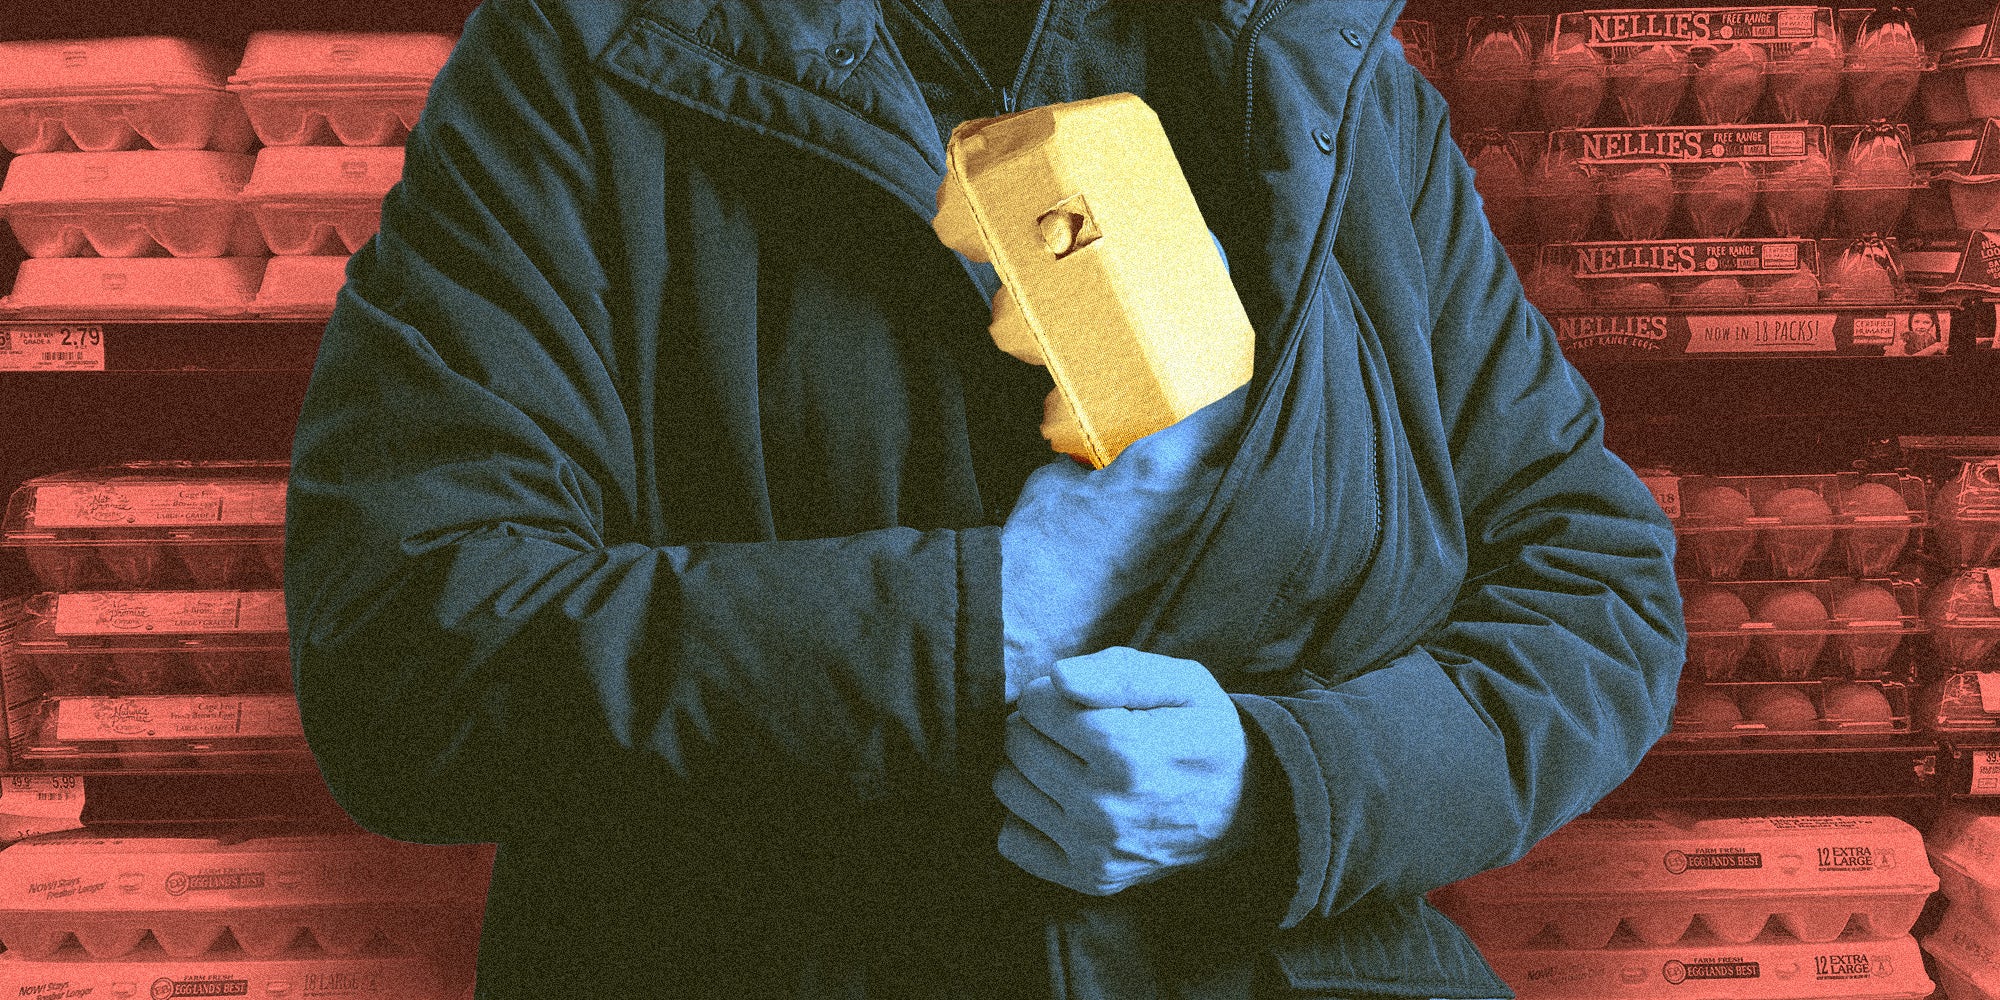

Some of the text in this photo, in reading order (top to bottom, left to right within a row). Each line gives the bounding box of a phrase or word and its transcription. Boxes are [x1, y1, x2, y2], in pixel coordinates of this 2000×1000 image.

[1722, 13, 1742, 25] FREE
[1745, 12, 1772, 25] RANGE
[1713, 132, 1733, 144] FREE
[1736, 131, 1763, 143] RANGE
[1706, 246, 1726, 257] FREE
[1729, 245, 1755, 257] RANGE
[61, 327, 100, 346] 2.79
[1705, 320, 1819, 341] NOW IN 18 PACKS!
[1660, 493, 1675, 503] 18
[52, 776, 75, 789] 5.99
[1738, 855, 1760, 866] BEST
[1817, 847, 1872, 866] 12 EXTRA
[1834, 856, 1873, 866] LARGE
[241, 875, 264, 887] BEST
[78, 882, 107, 894] Longer
[1814, 954, 1869, 974] 12 EXTRA
[1831, 964, 1870, 974] LARGE
[1735, 965, 1758, 976] BEST
[303, 973, 316, 991] 18
[319, 972, 359, 990] LARGE
[19, 981, 70, 997] NOW! Stays
[66, 987, 94, 999] Longer
[223, 982, 246, 994] BEST
